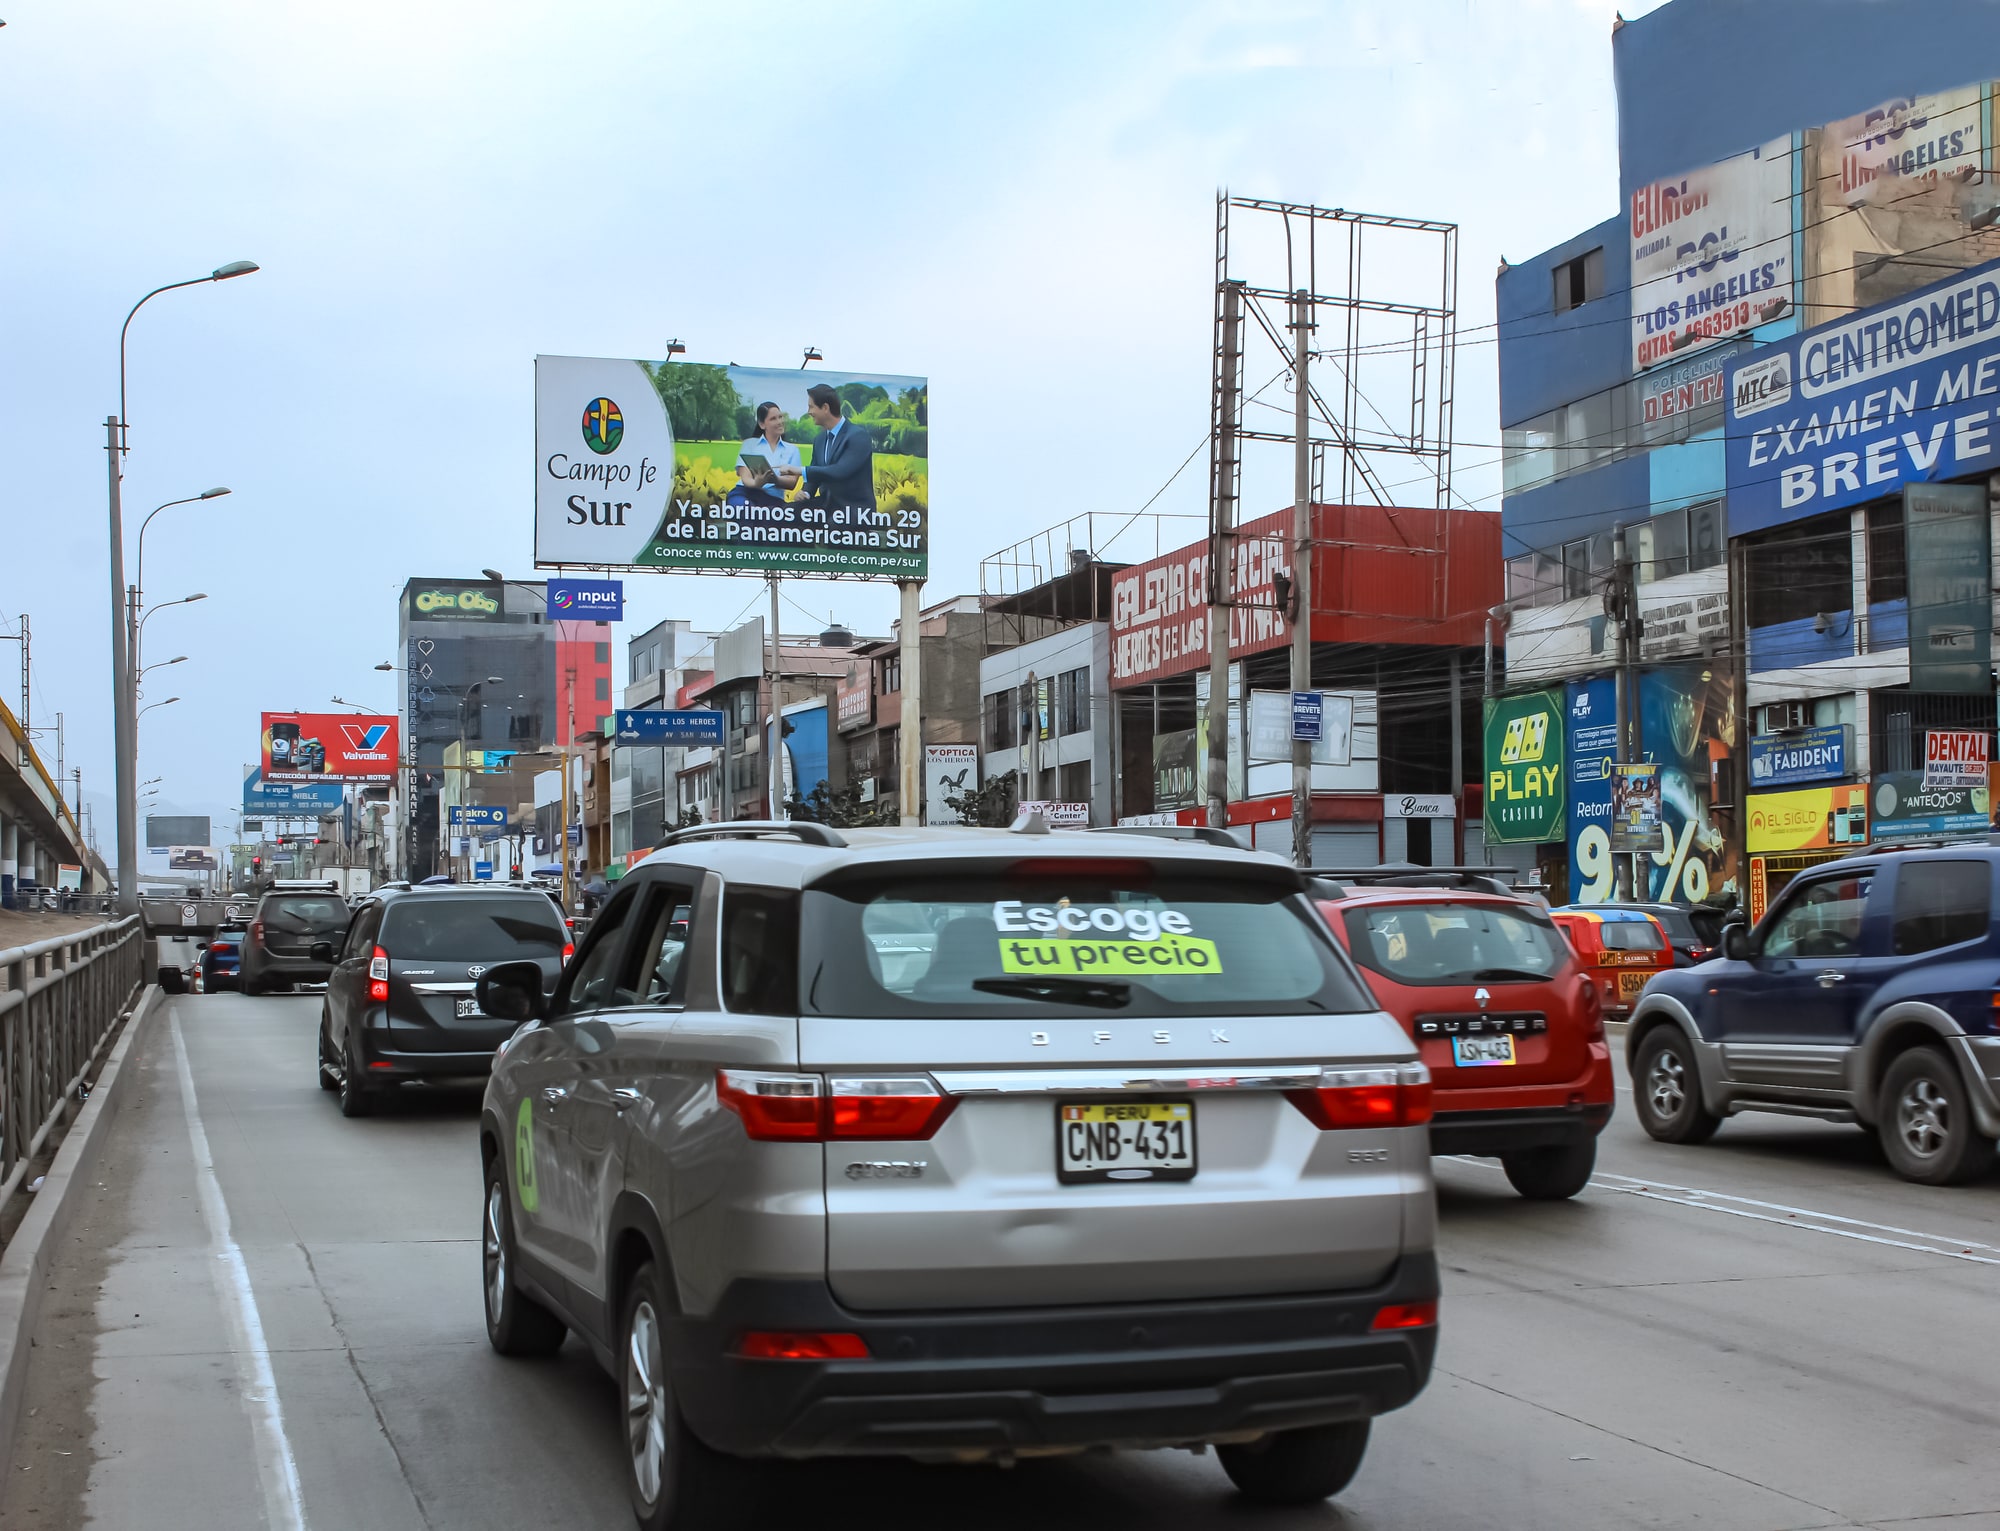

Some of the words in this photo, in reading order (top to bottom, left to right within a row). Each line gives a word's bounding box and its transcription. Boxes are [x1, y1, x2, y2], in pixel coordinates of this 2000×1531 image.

[1878, 124, 1974, 178] NGELES"
[1635, 236, 1665, 261] AFILIADO
[1638, 331, 1677, 364] CITAS
[1652, 350, 1738, 392] POLICLINICO
[1737, 375, 1769, 408] MTC
[1749, 380, 1918, 468] EXAMEN
[548, 453, 631, 491] Campo
[636, 457, 657, 492] fe
[1781, 406, 2000, 509] BREVE
[567, 495, 632, 526] Sur
[676, 499, 702, 518] Ya
[709, 501, 796, 522] abrimos
[801, 508, 827, 524] en
[832, 506, 851, 525] el
[857, 508, 891, 527] Km
[897, 510, 921, 529] 29
[666, 519, 694, 539] de
[701, 520, 719, 540] la
[726, 522, 880, 547] Panamericana
[886, 529, 922, 549] Sur
[655, 546, 702, 559] Conoce
[706, 547, 732, 560] más
[736, 550, 755, 561] en:
[758, 551, 922, 569] www.campofe.com.pe/sur
[1114, 563, 1185, 631] GALERIA
[1188, 530, 1291, 608] CORCIAL
[416, 592, 457, 613] Oba
[458, 591, 499, 614] Oba
[578, 590, 617, 604] input
[1116, 625, 1160, 679] HEROES
[1163, 626, 1178, 661] DE
[1181, 617, 1205, 655] LAS
[1207, 590, 1285, 653] LVINAS
[1573, 706, 1592, 717] PLAY
[343, 751, 388, 760] Valvoline
[939, 748, 975, 757] OPTICA
[1774, 744, 1841, 770] FABIDENT
[1928, 733, 1986, 761] DENTAL
[409, 736, 418, 817] RESTAURANT
[1490, 763, 1559, 802] PLAY
[1928, 763, 1963, 773] MAYAUTE
[456, 809, 488, 818] makro
[1400, 796, 1439, 816] Bianca
[1502, 805, 1543, 822] CASINO
[1768, 814, 1780, 827] EL
[1784, 811, 1817, 825] SIGLO
[993, 900, 1193, 942] Escoge
[1009, 941, 1062, 967] tu
[1070, 940, 1210, 972] precio
[1421, 1019, 1547, 1033] DUSTER
[1104, 1106, 1151, 1120] PERU
[1068, 1120, 1188, 1162] CNB-431
